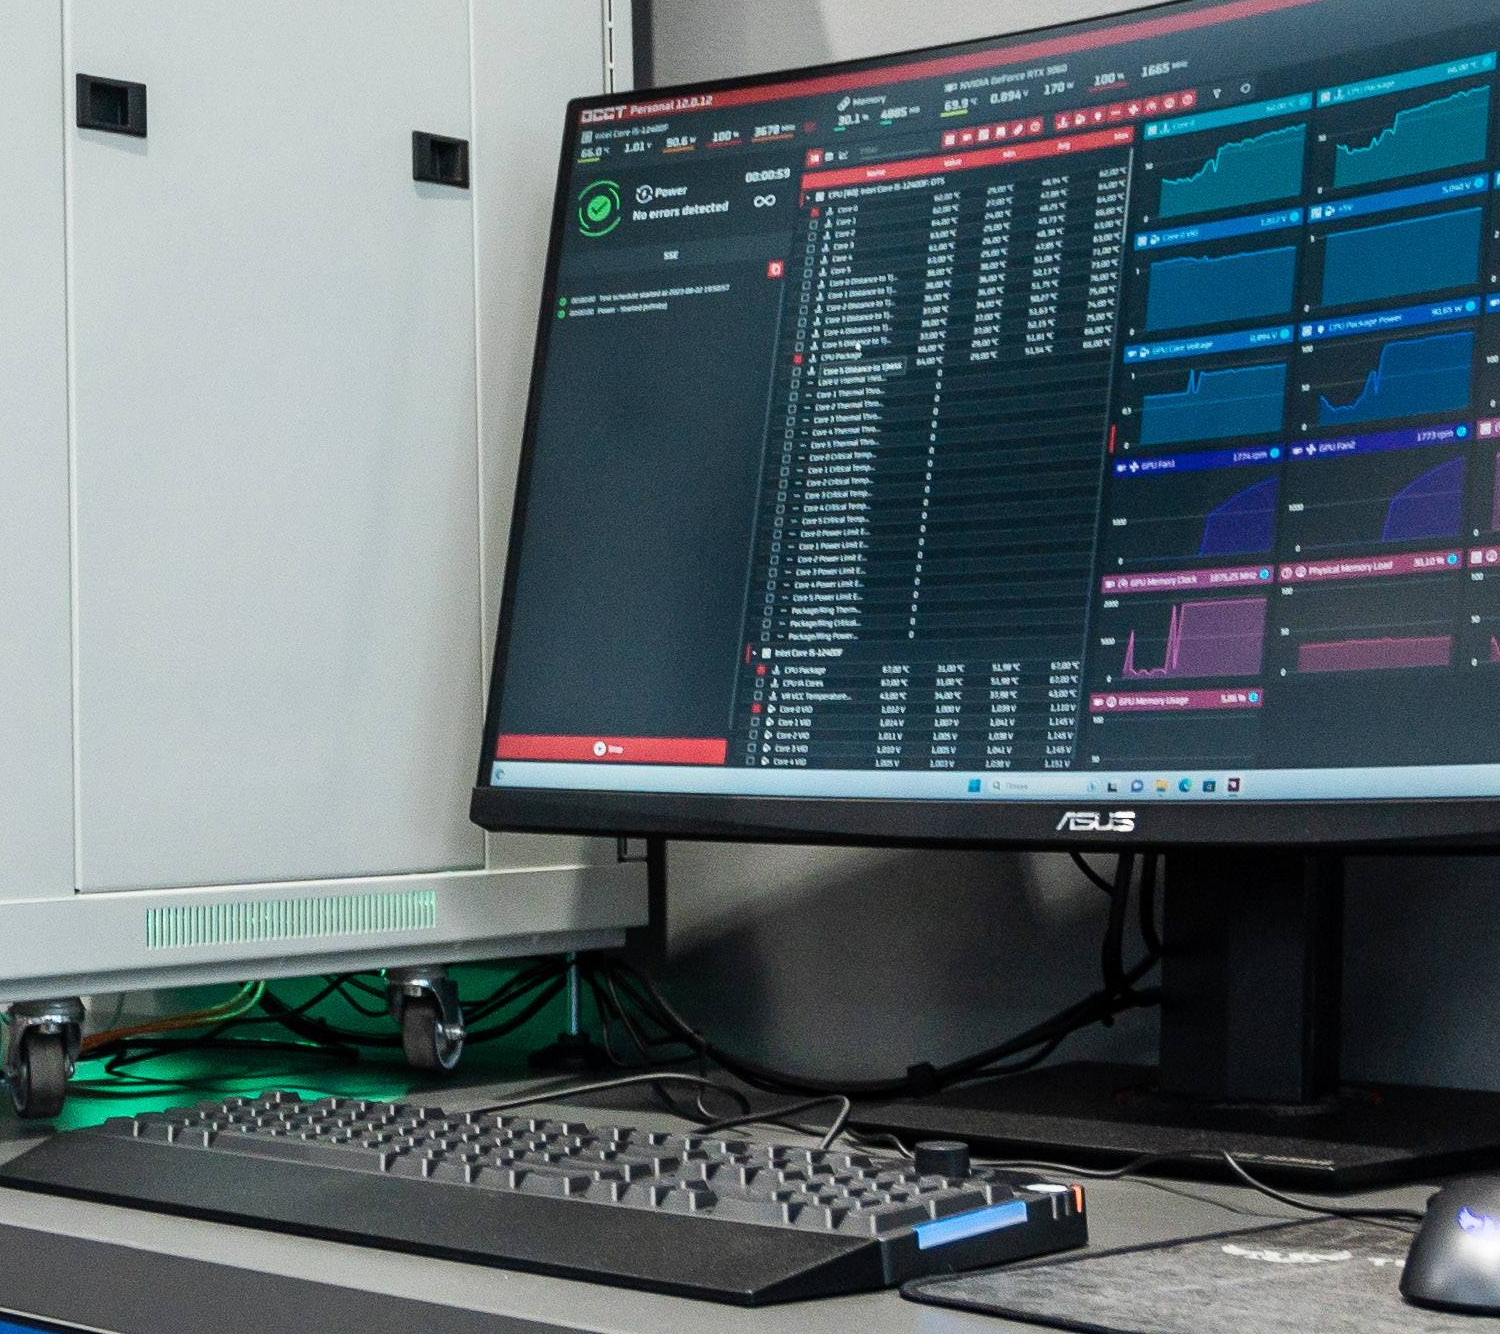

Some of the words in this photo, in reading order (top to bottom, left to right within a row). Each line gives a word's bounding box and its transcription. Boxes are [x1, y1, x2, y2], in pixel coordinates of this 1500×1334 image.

[1044, 82, 1065, 95] 170
[1093, 73, 1115, 87] 100
[1141, 63, 1170, 78] 1665
[852, 94, 886, 107] Memory
[581, 106, 626, 122] OCCT
[630, 100, 674, 116] Personal
[713, 131, 732, 142] 100
[745, 168, 790, 183] 00:00:59
[655, 186, 687, 198] Power
[633, 209, 647, 221] No
[650, 207, 680, 219] errors
[682, 201, 729, 216] detected
[1371, 560, 1393, 571] Load
[1056, 811, 1136, 833] ASUS
